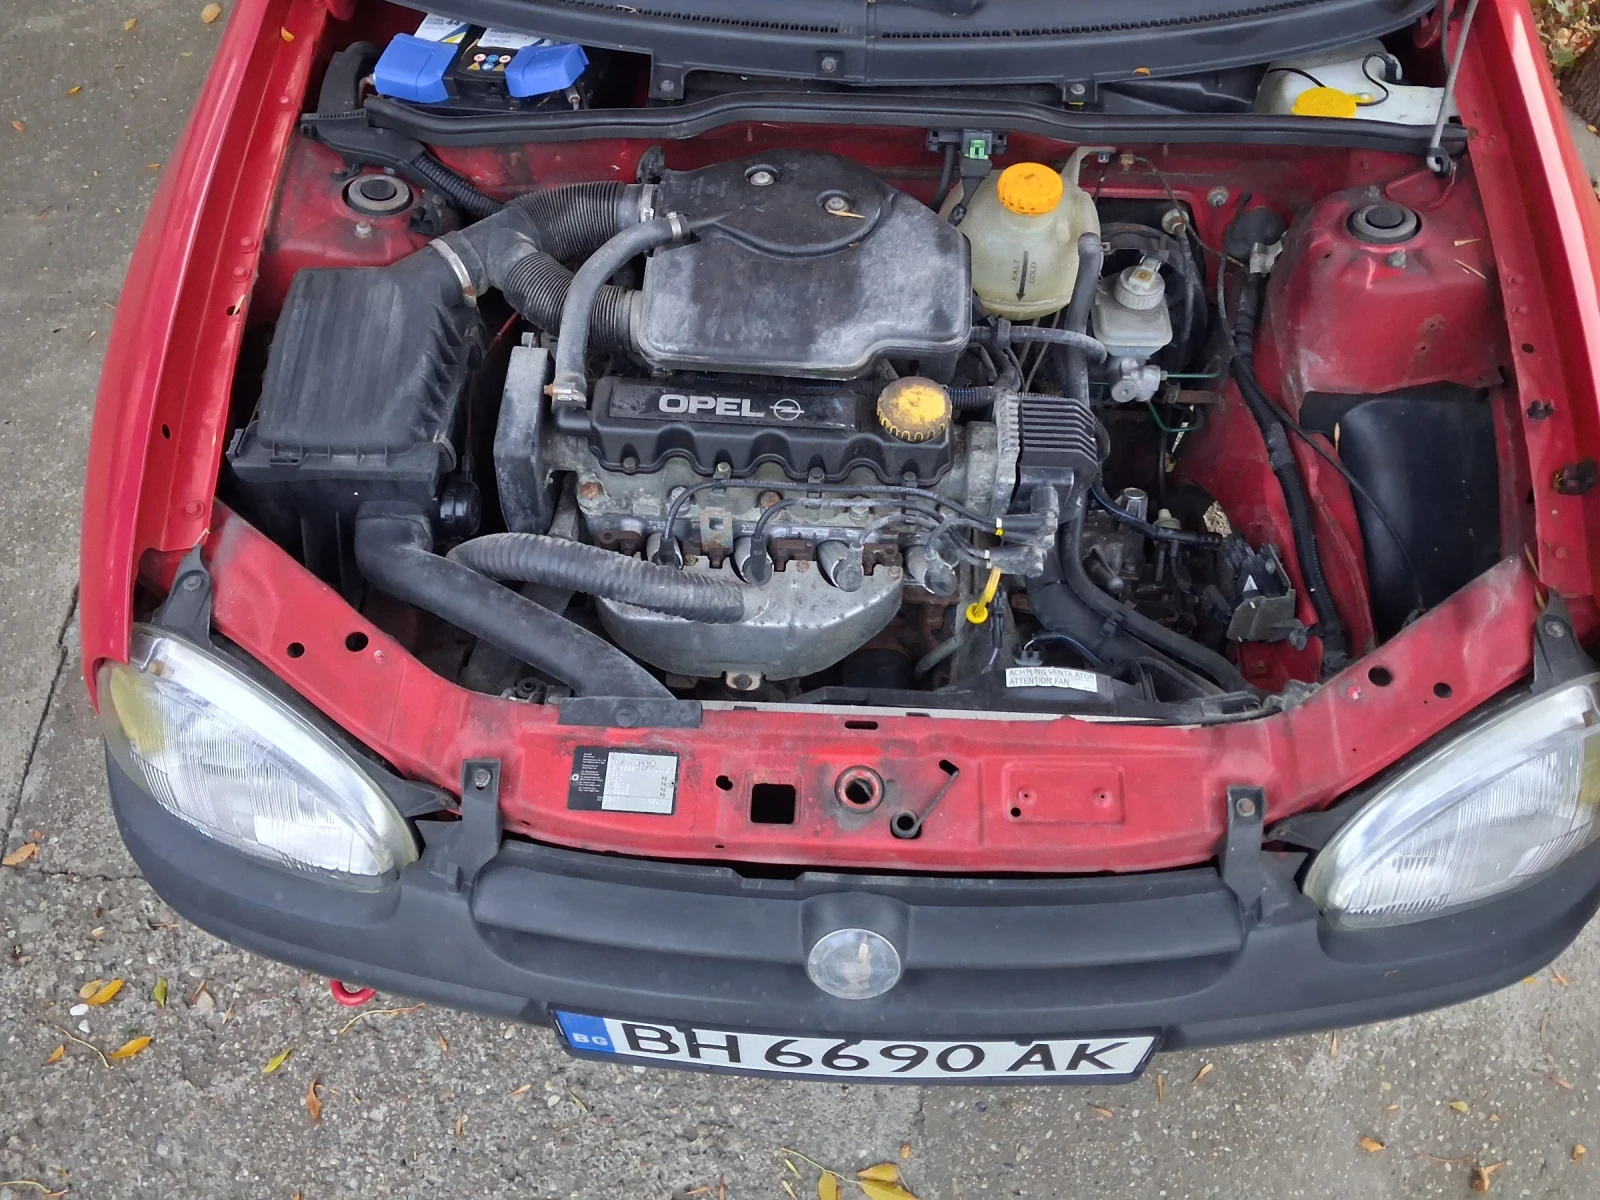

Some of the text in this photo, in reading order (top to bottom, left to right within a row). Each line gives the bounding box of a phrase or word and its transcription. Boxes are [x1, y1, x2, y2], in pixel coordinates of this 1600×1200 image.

[1012, 258, 1020, 281] KALT
[659, 394, 765, 417] OPEL
[1009, 669, 1095, 680] ACHTUNG VENTILATOR
[1010, 677, 1070, 686] ATTENTION FAN
[572, 1033, 608, 1046] BG
[621, 1022, 1130, 1072] BH 6690 AK
